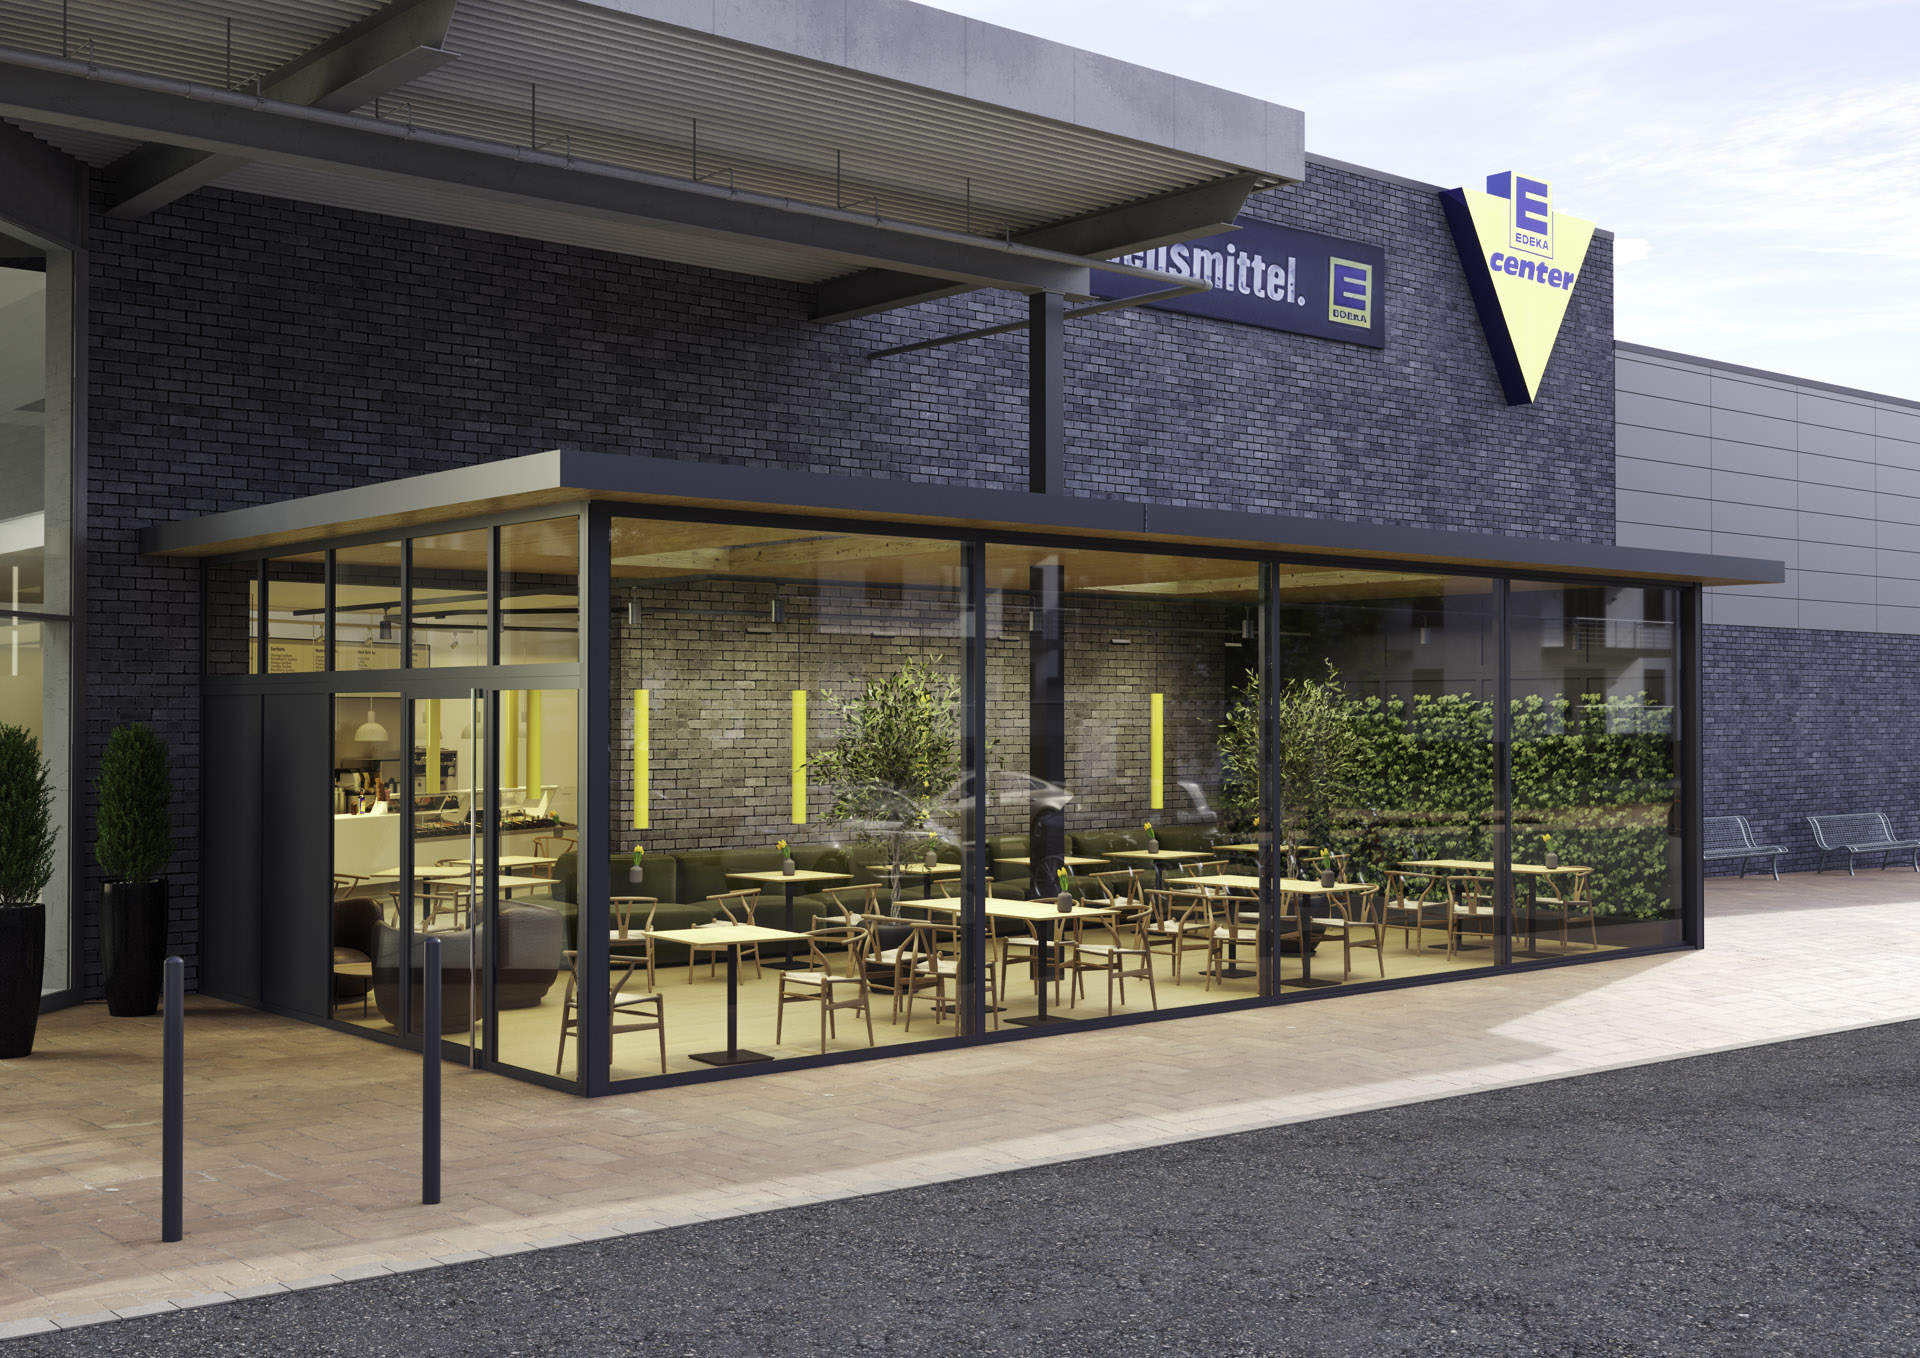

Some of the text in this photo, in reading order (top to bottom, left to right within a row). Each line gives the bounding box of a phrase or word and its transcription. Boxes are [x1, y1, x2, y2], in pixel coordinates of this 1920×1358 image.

[1516, 176, 1548, 236] E
[1515, 232, 1550, 251] EDEKA
[1105, 243, 1306, 306] nsmittel.
[1333, 264, 1367, 311] E
[1490, 252, 1575, 291] center
[1332, 308, 1368, 324] EDEKA
